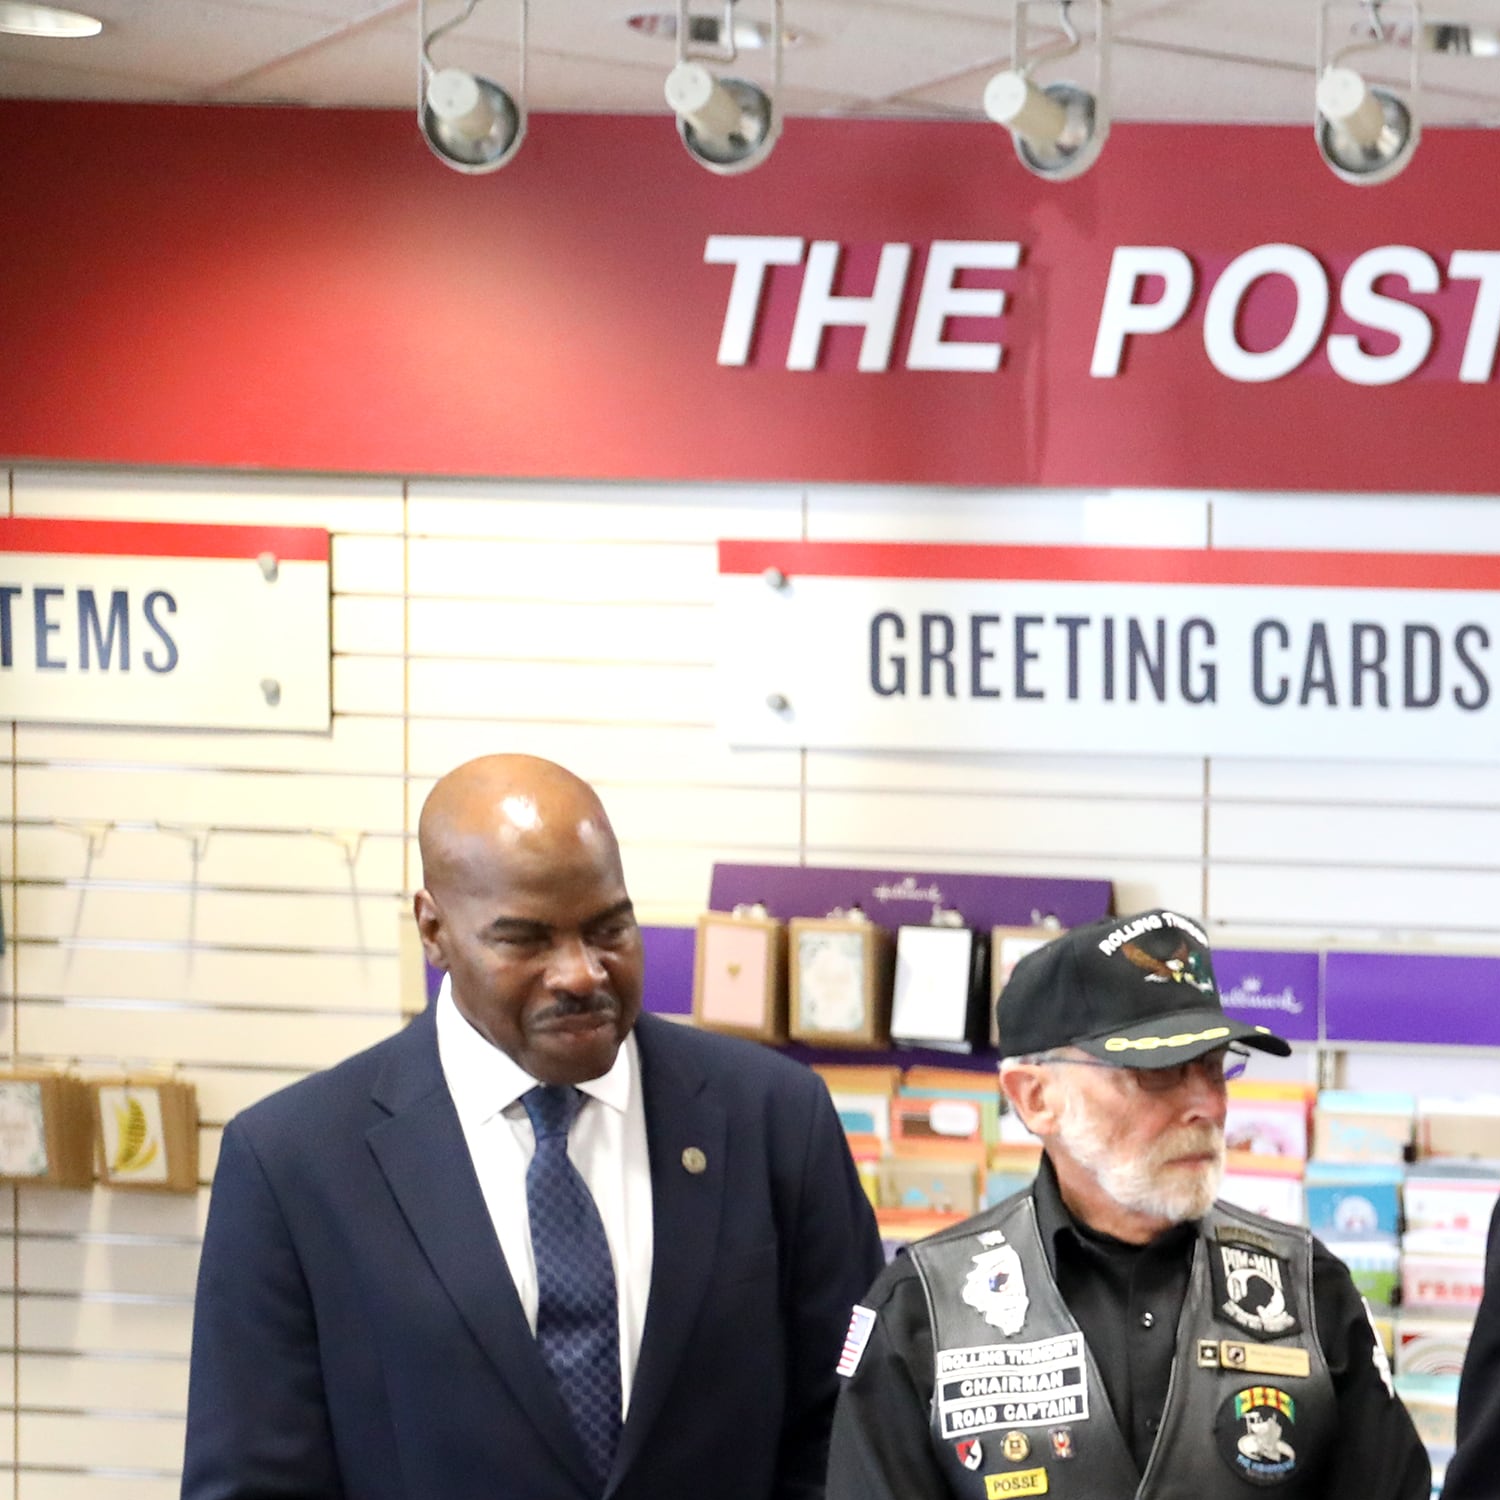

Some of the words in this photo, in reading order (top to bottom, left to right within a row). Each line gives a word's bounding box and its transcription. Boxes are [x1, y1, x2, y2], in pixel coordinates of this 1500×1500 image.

[704, 235, 1021, 373] THE
[869, 610, 1217, 705] GREETING
[1252, 618, 1492, 712] CARDS
[1099, 915, 1163, 956] ROLLING
[942, 1351, 1006, 1373] ROLLING
[960, 1370, 1064, 1397] CHAIRMAN
[952, 1406, 998, 1431] ROAD
[1004, 1397, 1077, 1422] CAPTAIN
[993, 1475, 1039, 1493] POSSE
